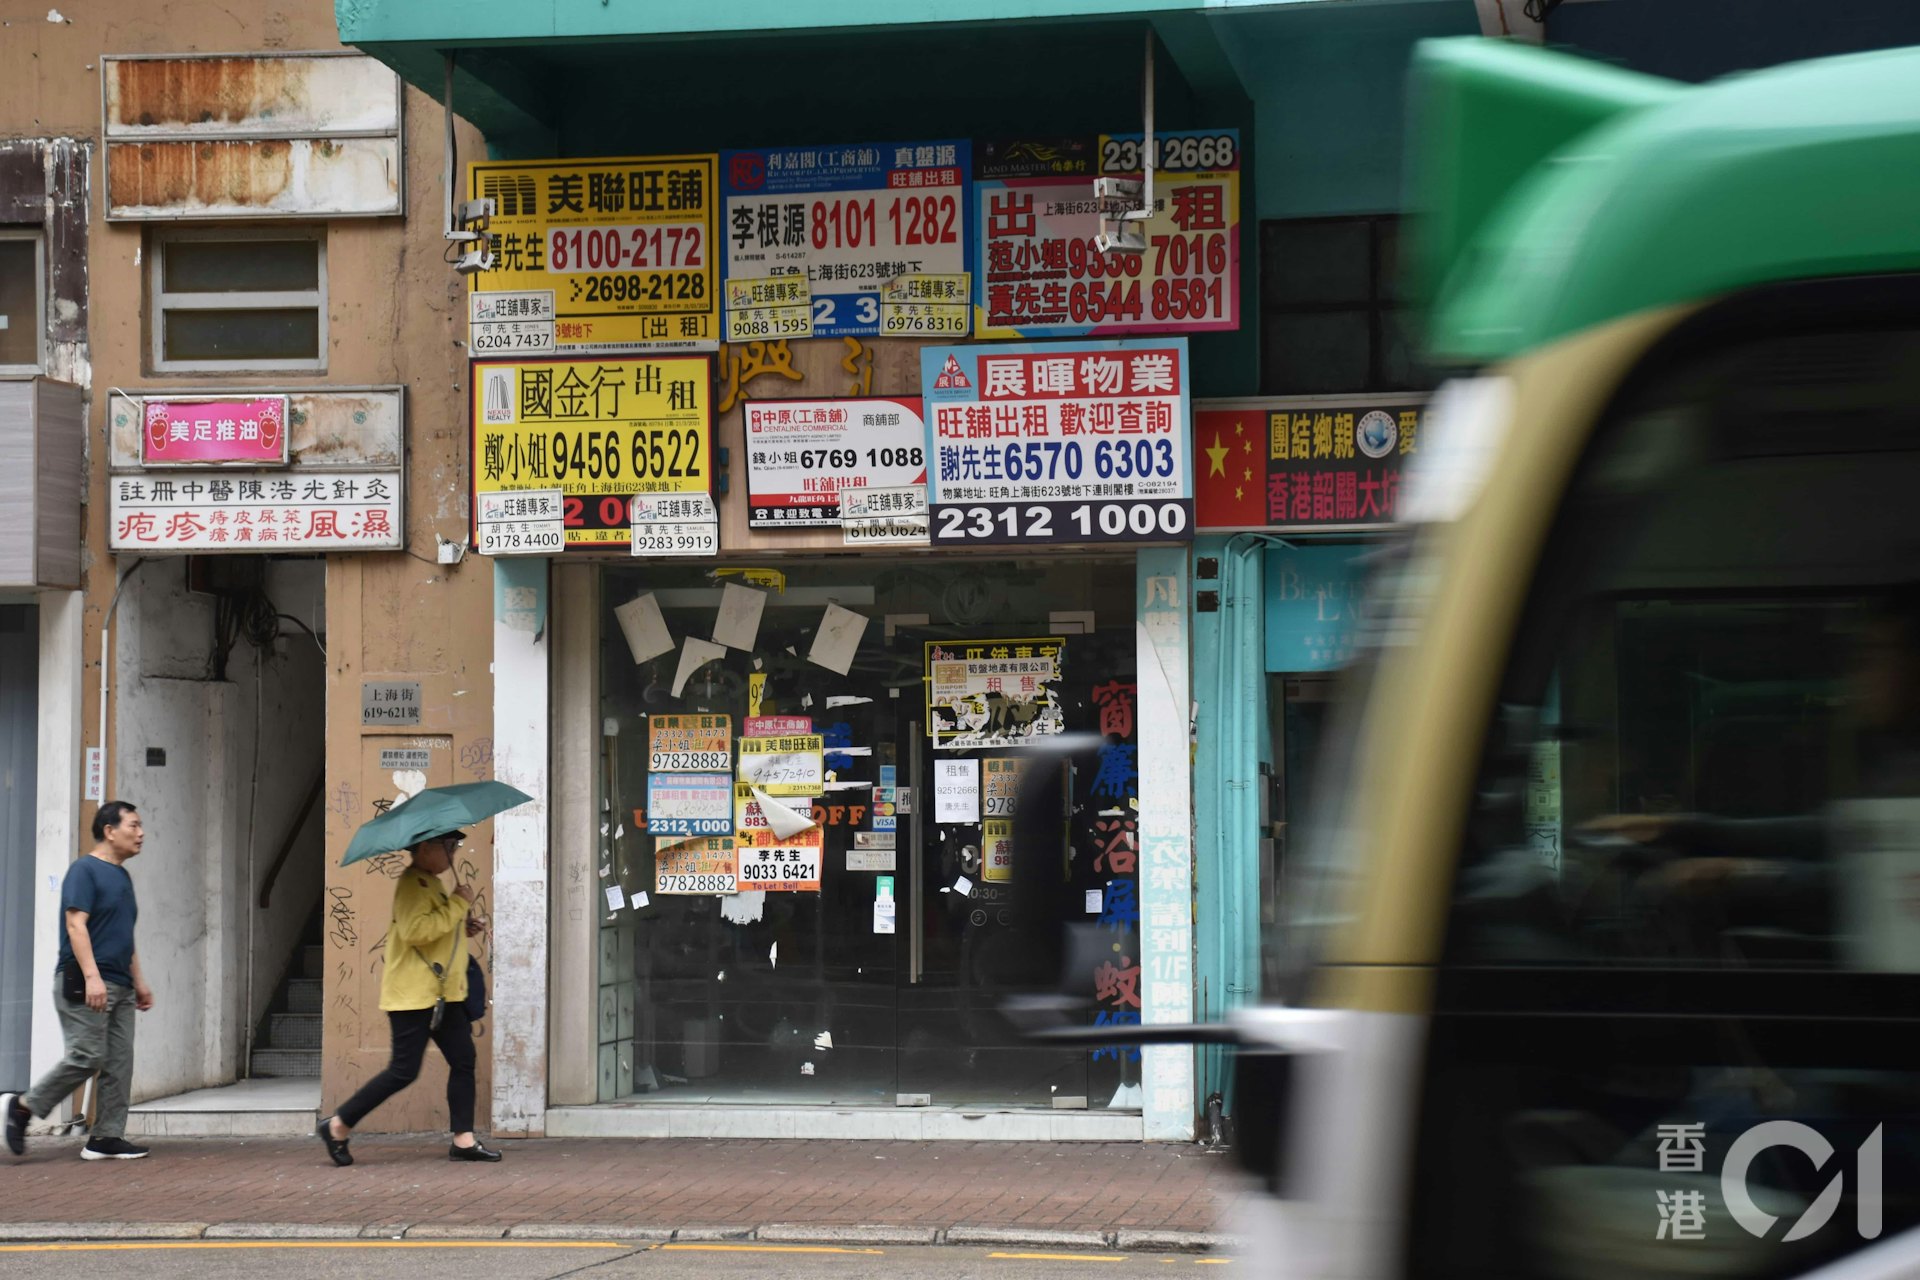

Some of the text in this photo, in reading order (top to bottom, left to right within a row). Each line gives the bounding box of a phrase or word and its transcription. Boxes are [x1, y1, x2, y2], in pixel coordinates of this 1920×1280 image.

[895, 145, 956, 168] 真盤源
[1164, 136, 1234, 169] 2668
[983, 162, 1009, 174] LAND
[892, 170, 955, 187] 旺舖出租
[547, 169, 703, 214] 美聯旺舖
[989, 185, 1226, 238] 出 租
[732, 195, 957, 250] 李根源 8101 1282
[552, 227, 701, 270] 8100-2172
[988, 233, 1226, 276] 范小姐 7016
[585, 273, 705, 302] 2698-2128
[752, 283, 799, 302] 旺舖專家
[908, 279, 956, 298] 旺舖專家
[496, 298, 542, 316] 旺舖專家
[1069, 280, 1143, 323] 6544
[1151, 277, 1223, 321] 8581
[734, 321, 769, 336] 9088
[775, 318, 808, 333] 1595
[887, 317, 923, 331] 6976
[927, 316, 963, 330] 8316
[477, 335, 511, 348] 6204
[516, 334, 549, 347] 7437
[984, 354, 1174, 397] 展暉物業
[520, 366, 625, 420] 國金行
[763, 408, 900, 427] 中原(工商舖) 商舖部
[937, 401, 1172, 439] 旺舖出租 歡迎查詢
[170, 419, 258, 442] 美足推油
[1271, 412, 1354, 460] 團結鄉親
[483, 429, 700, 481] 鄭小姐 9456 6522
[801, 449, 857, 469] 6769
[866, 447, 923, 468] 1088
[940, 438, 1174, 482] 謝先生 6570 6303
[943, 487, 986, 499] 物業地址:
[504, 499, 549, 515] 旺舖專家
[657, 501, 703, 517] 旺舖專家
[867, 493, 915, 512] 旺舖專家
[118, 511, 206, 542] 疱疹
[304, 509, 391, 540] 風濕
[491, 523, 530, 533] 胡先生
[937, 503, 1186, 538] 2312 1000
[486, 533, 559, 548] 9178 4400
[639, 536, 712, 549] 9283 9919
[371, 688, 413, 701] 上海街
[364, 707, 419, 718] 619-621號
[700, 729, 725, 737] 1473
[765, 738, 819, 751] 美聯旺舖
[653, 753, 728, 769] 97828882
[946, 765, 969, 776] 租售
[937, 787, 978, 795] 92512666
[650, 820, 730, 832] 2312 1000
[759, 850, 800, 861] 李先生
[744, 864, 814, 879] 9033 6421
[659, 875, 735, 891] 97828882
